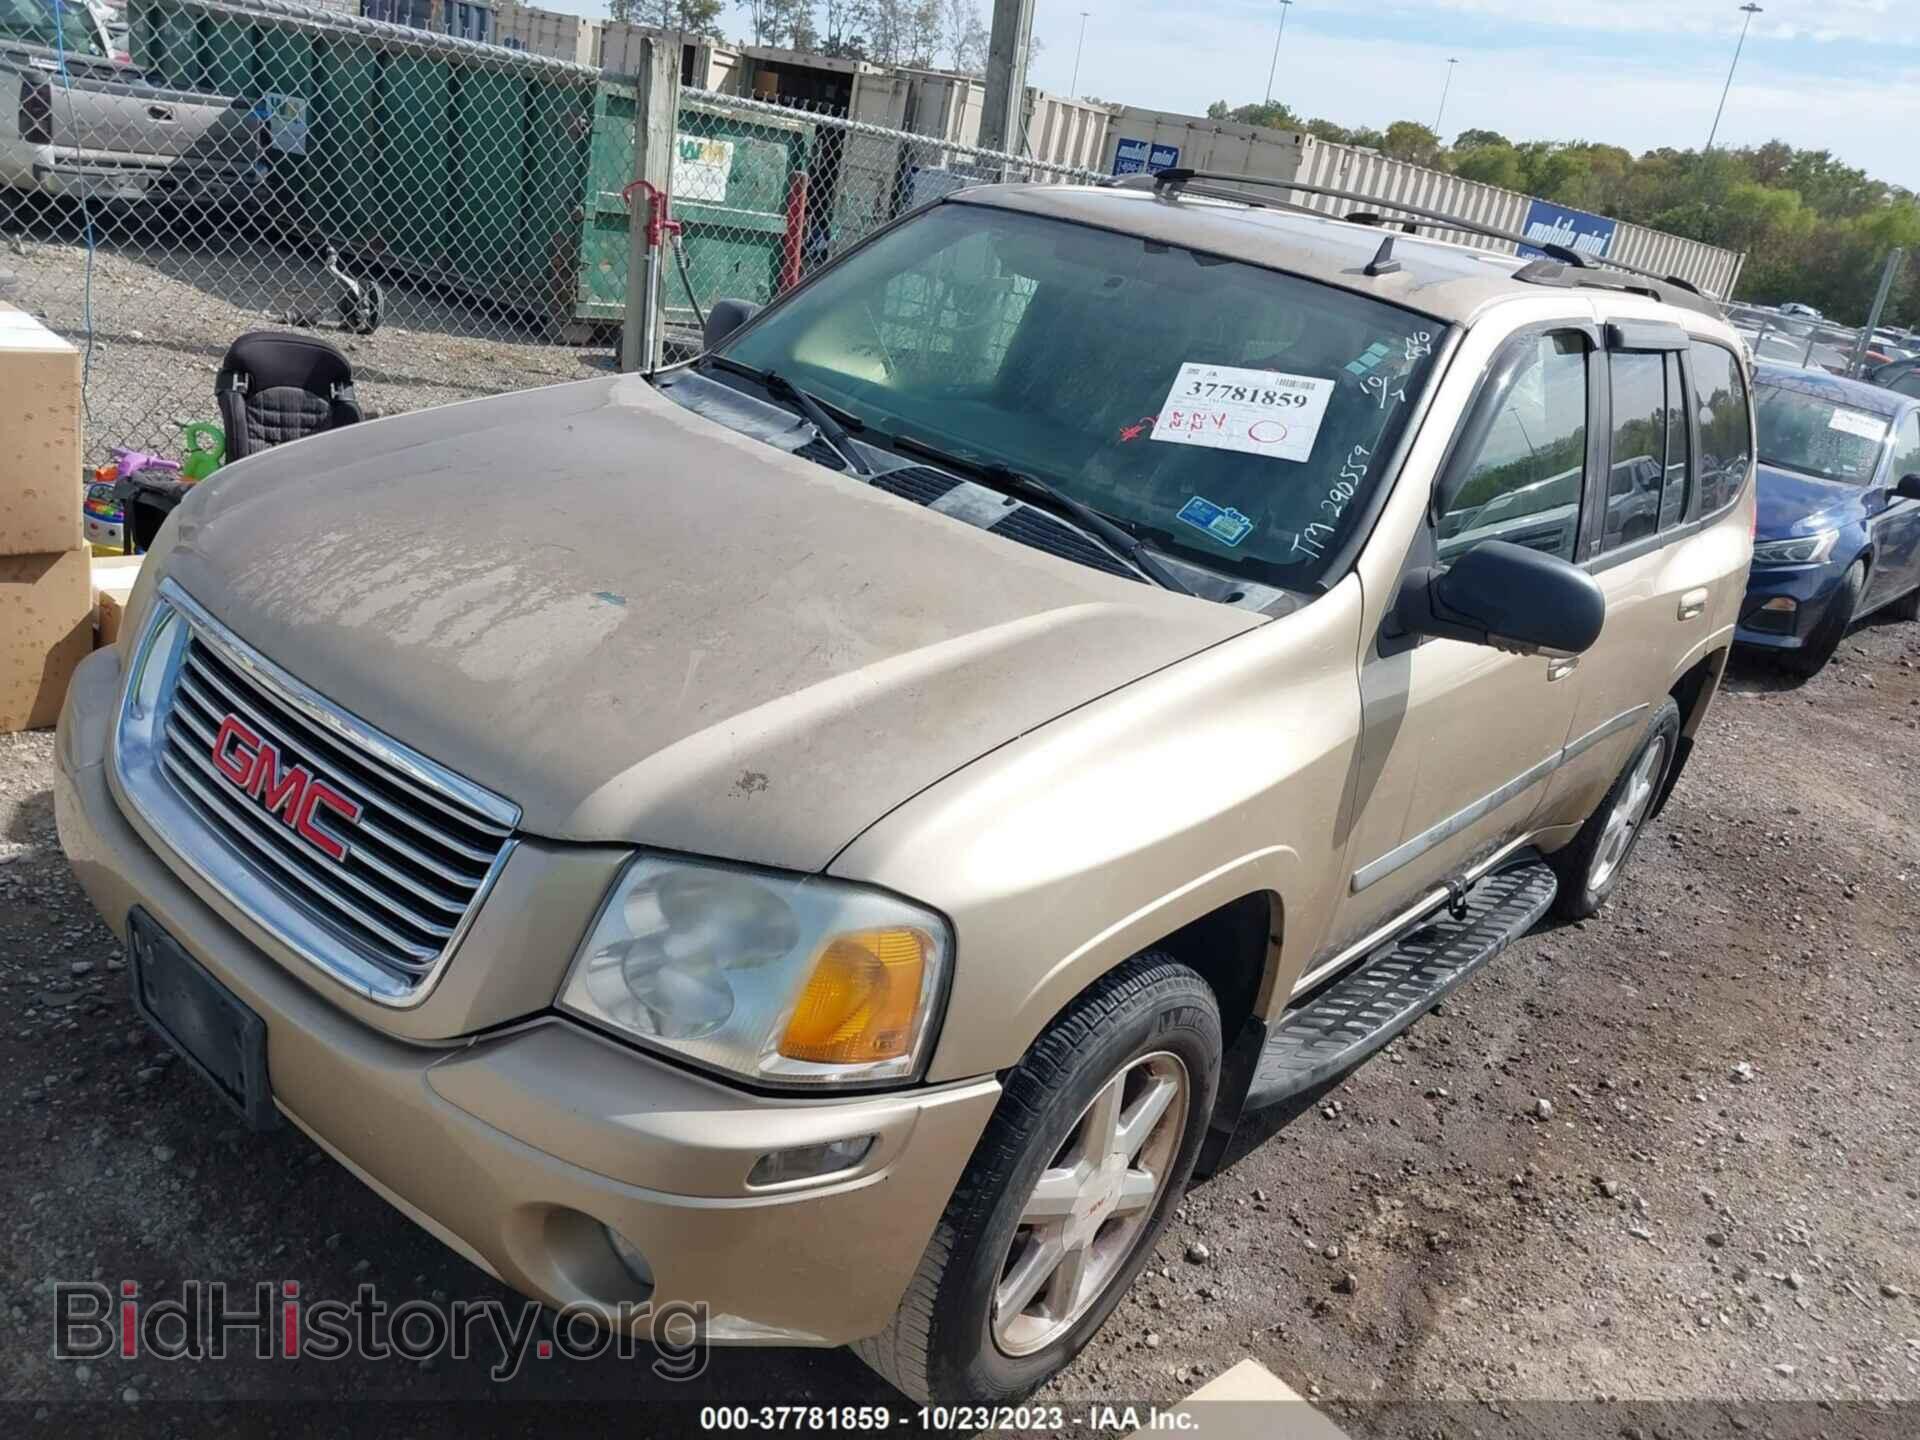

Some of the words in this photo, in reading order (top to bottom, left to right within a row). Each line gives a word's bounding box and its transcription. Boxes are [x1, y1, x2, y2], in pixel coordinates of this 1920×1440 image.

[1526, 215, 1577, 248] mobile
[1571, 230, 1611, 257] mini
[1185, 381, 1308, 409] 37781859
[1290, 522, 1336, 559] TM
[1320, 444, 1370, 518] 290559
[212, 712, 364, 862] GMC
